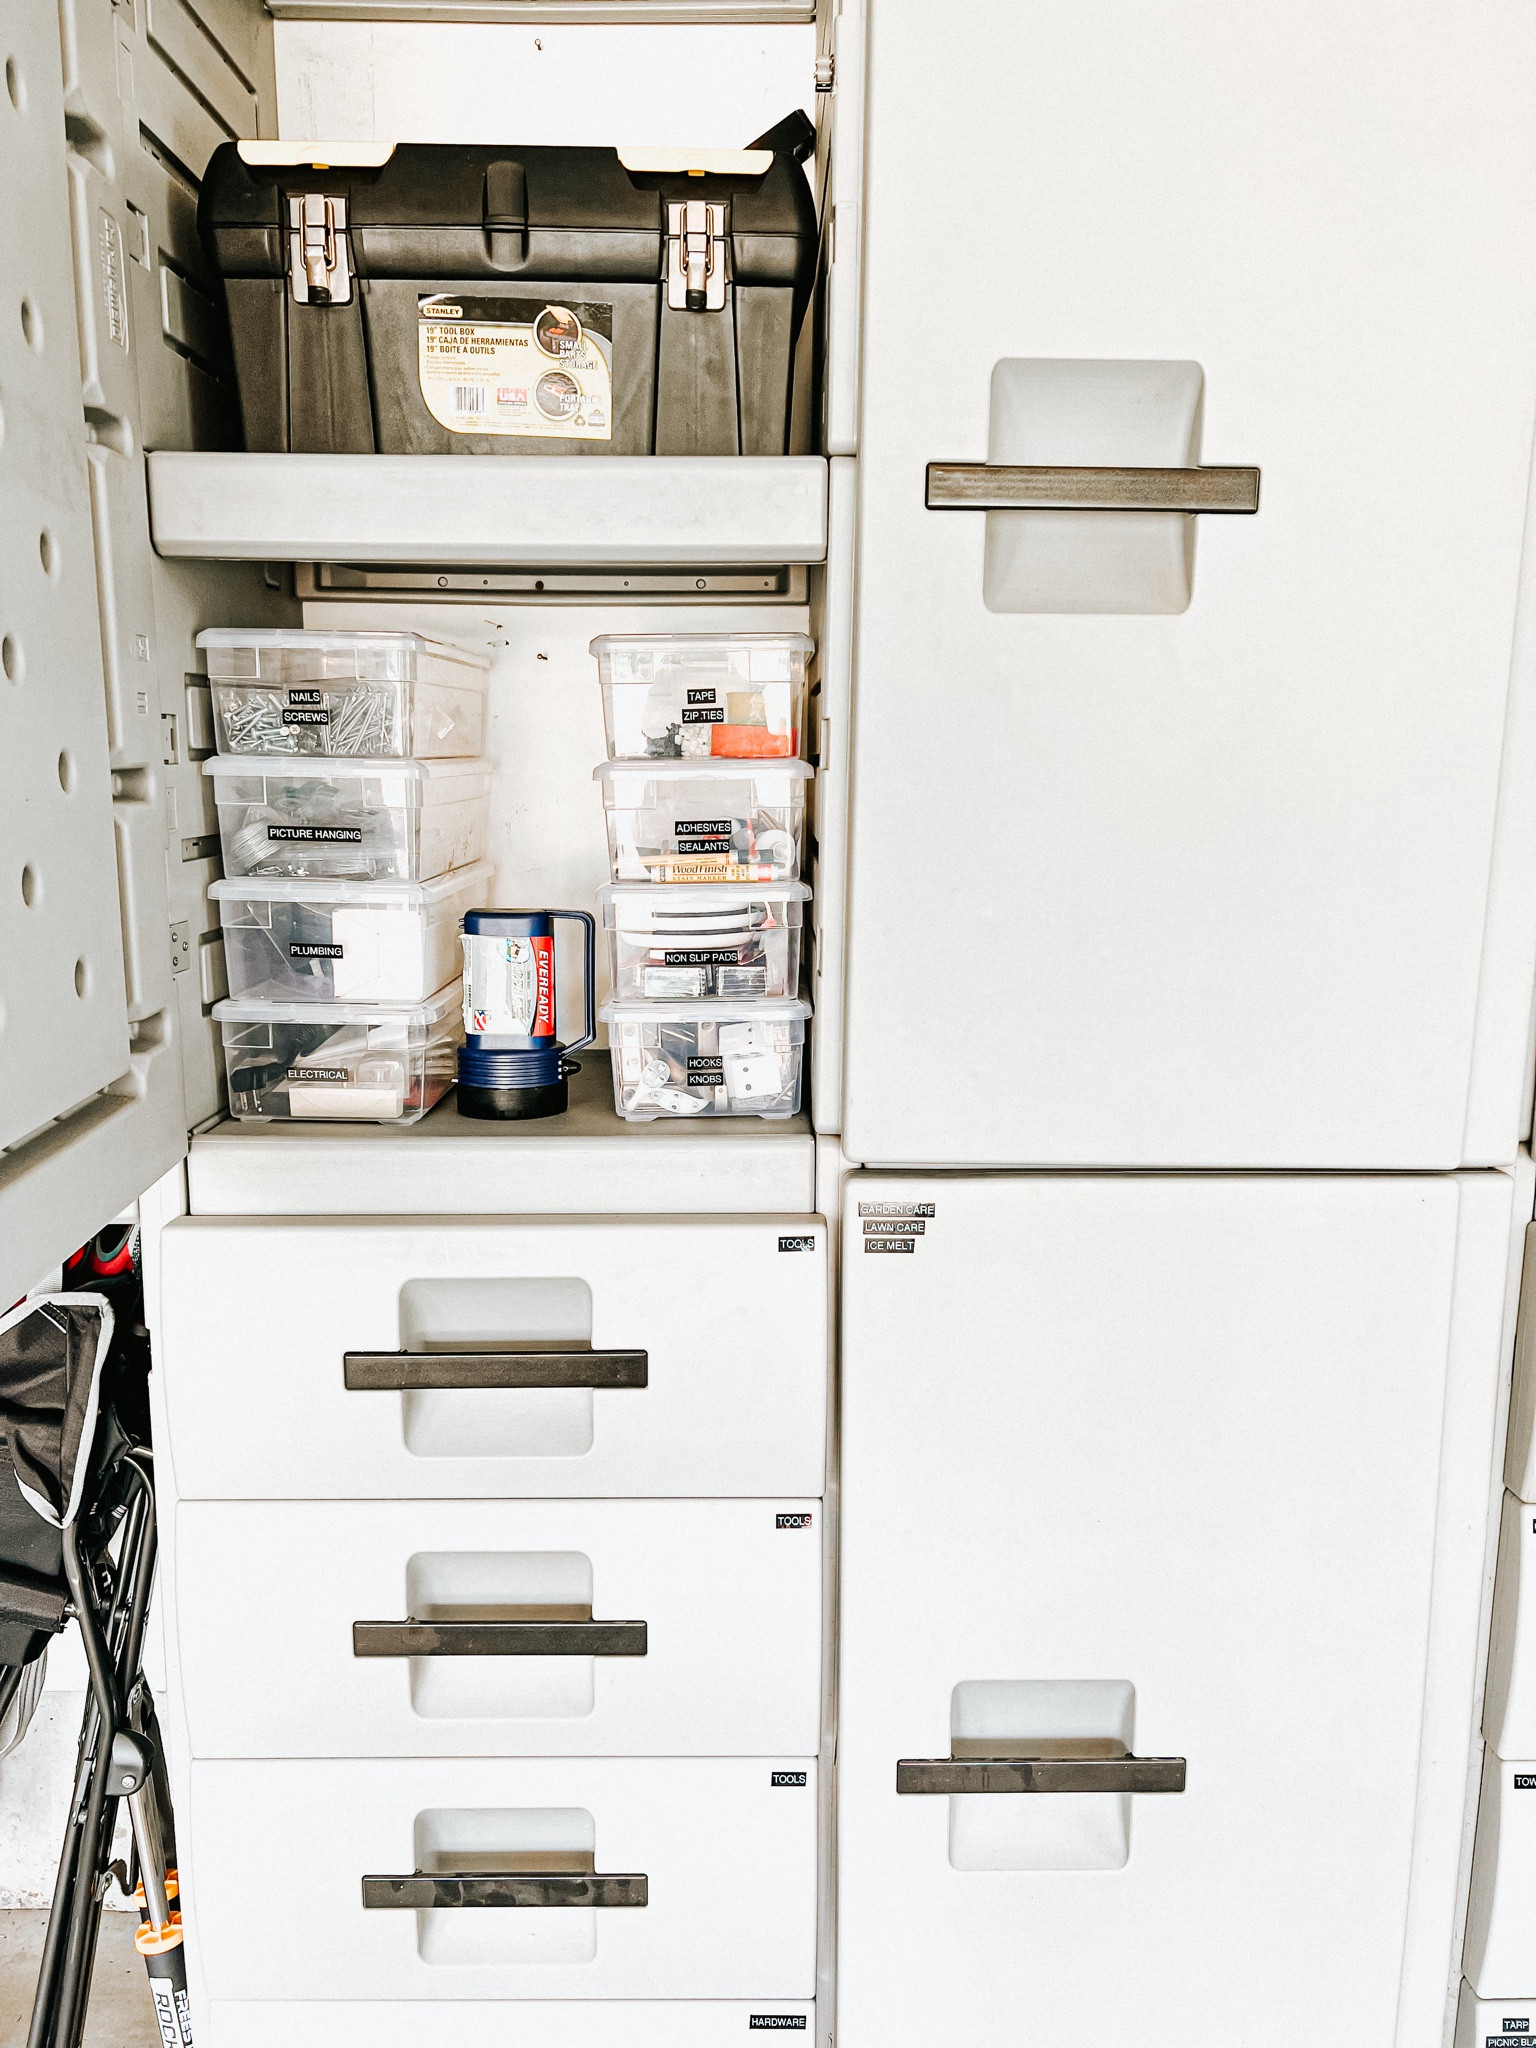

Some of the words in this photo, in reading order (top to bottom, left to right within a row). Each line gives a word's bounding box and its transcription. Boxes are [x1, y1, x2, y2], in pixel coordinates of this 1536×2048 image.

[439, 327, 458, 335] TOOL
[426, 336, 437, 344] 19"
[439, 336, 458, 344] CAJA
[471, 338, 528, 347] HERRAMIENTAS
[470, 346, 495, 354] OUTILS
[560, 360, 598, 369] STORAGE
[560, 404, 580, 412] TRAY
[290, 692, 320, 702] NAILS
[688, 691, 714, 701] TAPE
[284, 712, 328, 722] SCREWS
[684, 712, 699, 720] ZIP
[702, 710, 723, 720] TIES
[676, 823, 730, 832] ADHESIVES
[270, 828, 313, 838] PICTURE
[315, 830, 361, 840] HANGING
[680, 842, 729, 851] SEALANTS
[291, 946, 342, 956] PLUMBING
[666, 954, 687, 963] NON
[689, 954, 710, 962] SLIP
[712, 953, 737, 961] PADS
[539, 950, 549, 1022] EVEREADY
[690, 1058, 722, 1067] HOOKS
[288, 1070, 348, 1079] ELECTRICAL
[690, 1075, 722, 1083] KNOBS
[860, 1205, 904, 1214] GARDEN
[906, 1205, 934, 1215] CARE
[866, 1223, 894, 1232] LAWN
[896, 1223, 924, 1232] CARE
[780, 1238, 814, 1249] TOOLS
[867, 1241, 884, 1250] ICE
[886, 1241, 913, 1250] MELT
[777, 1516, 811, 1526] TOOLS
[773, 1775, 805, 1784] TOOLS
[751, 2017, 805, 2027] HARDWARE
[1504, 2020, 1529, 2030] TARP
[1488, 2038, 1519, 2047] PICNIC
